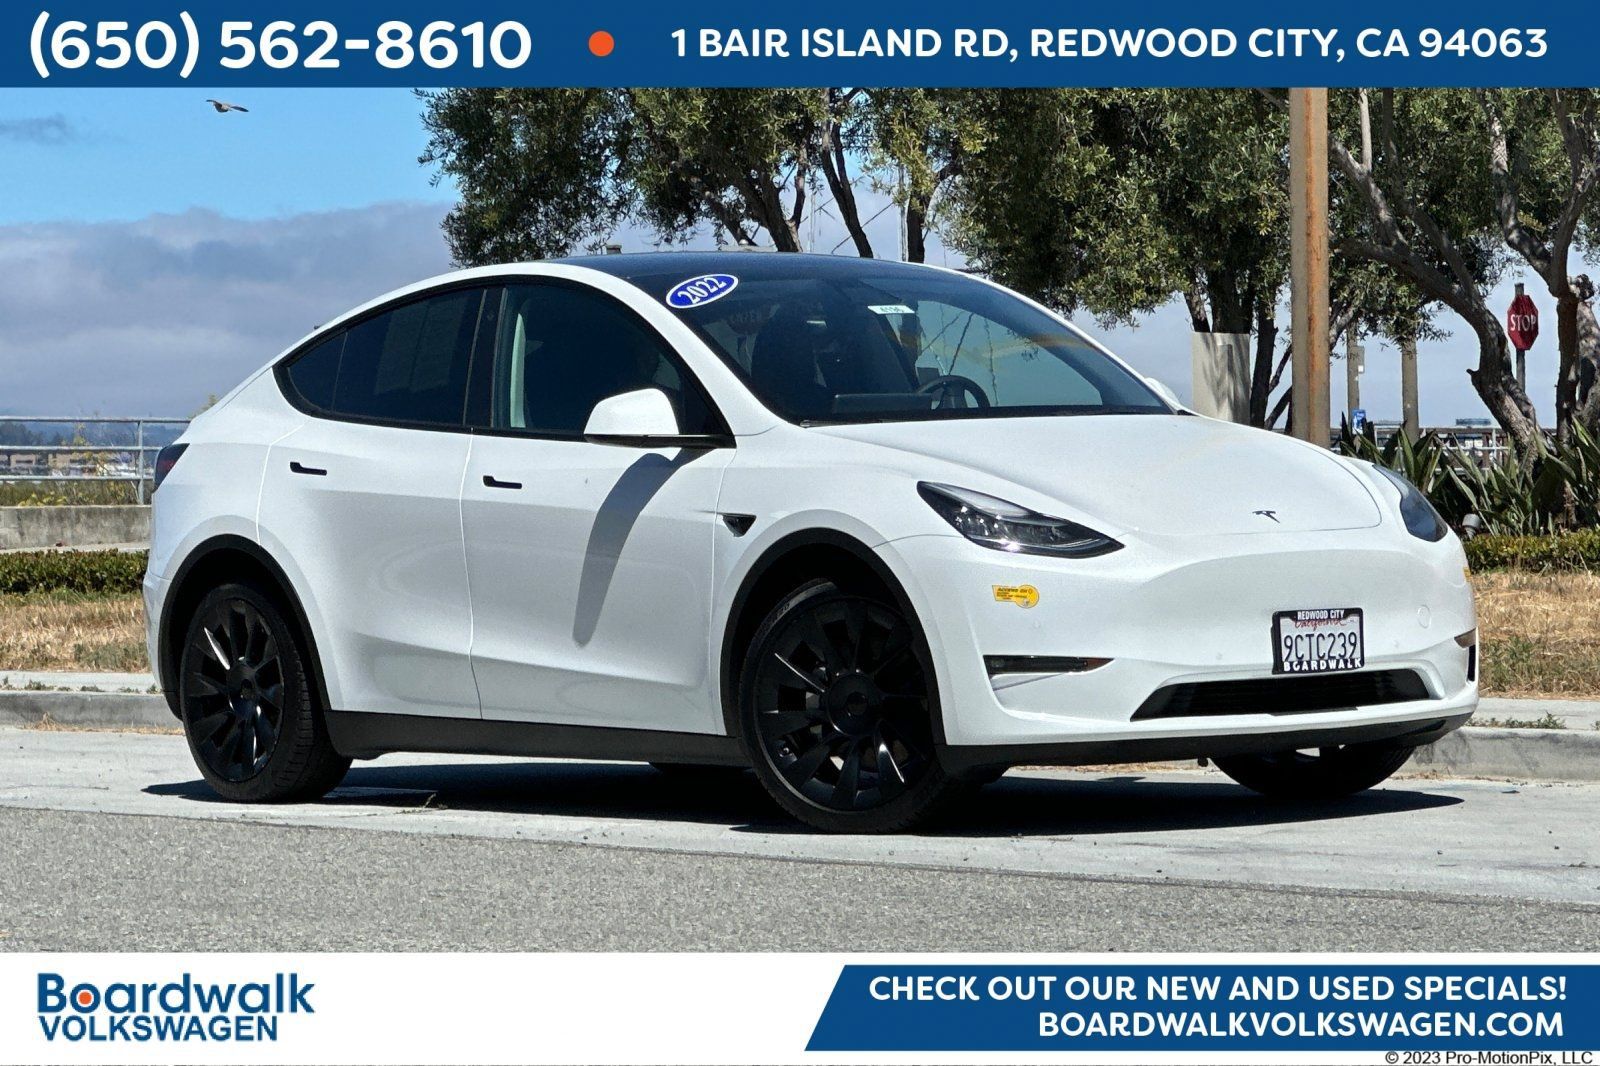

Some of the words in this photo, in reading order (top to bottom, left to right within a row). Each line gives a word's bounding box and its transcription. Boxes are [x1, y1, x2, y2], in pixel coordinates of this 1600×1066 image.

[677, 277, 727, 304] 2022
[1510, 314, 1537, 332] STOP
[1297, 610, 1328, 620] REDWOOD
[1330, 609, 1345, 619] CITY
[1284, 632, 1358, 661] 9CTC239
[1283, 659, 1362, 672] BOARDWALK
